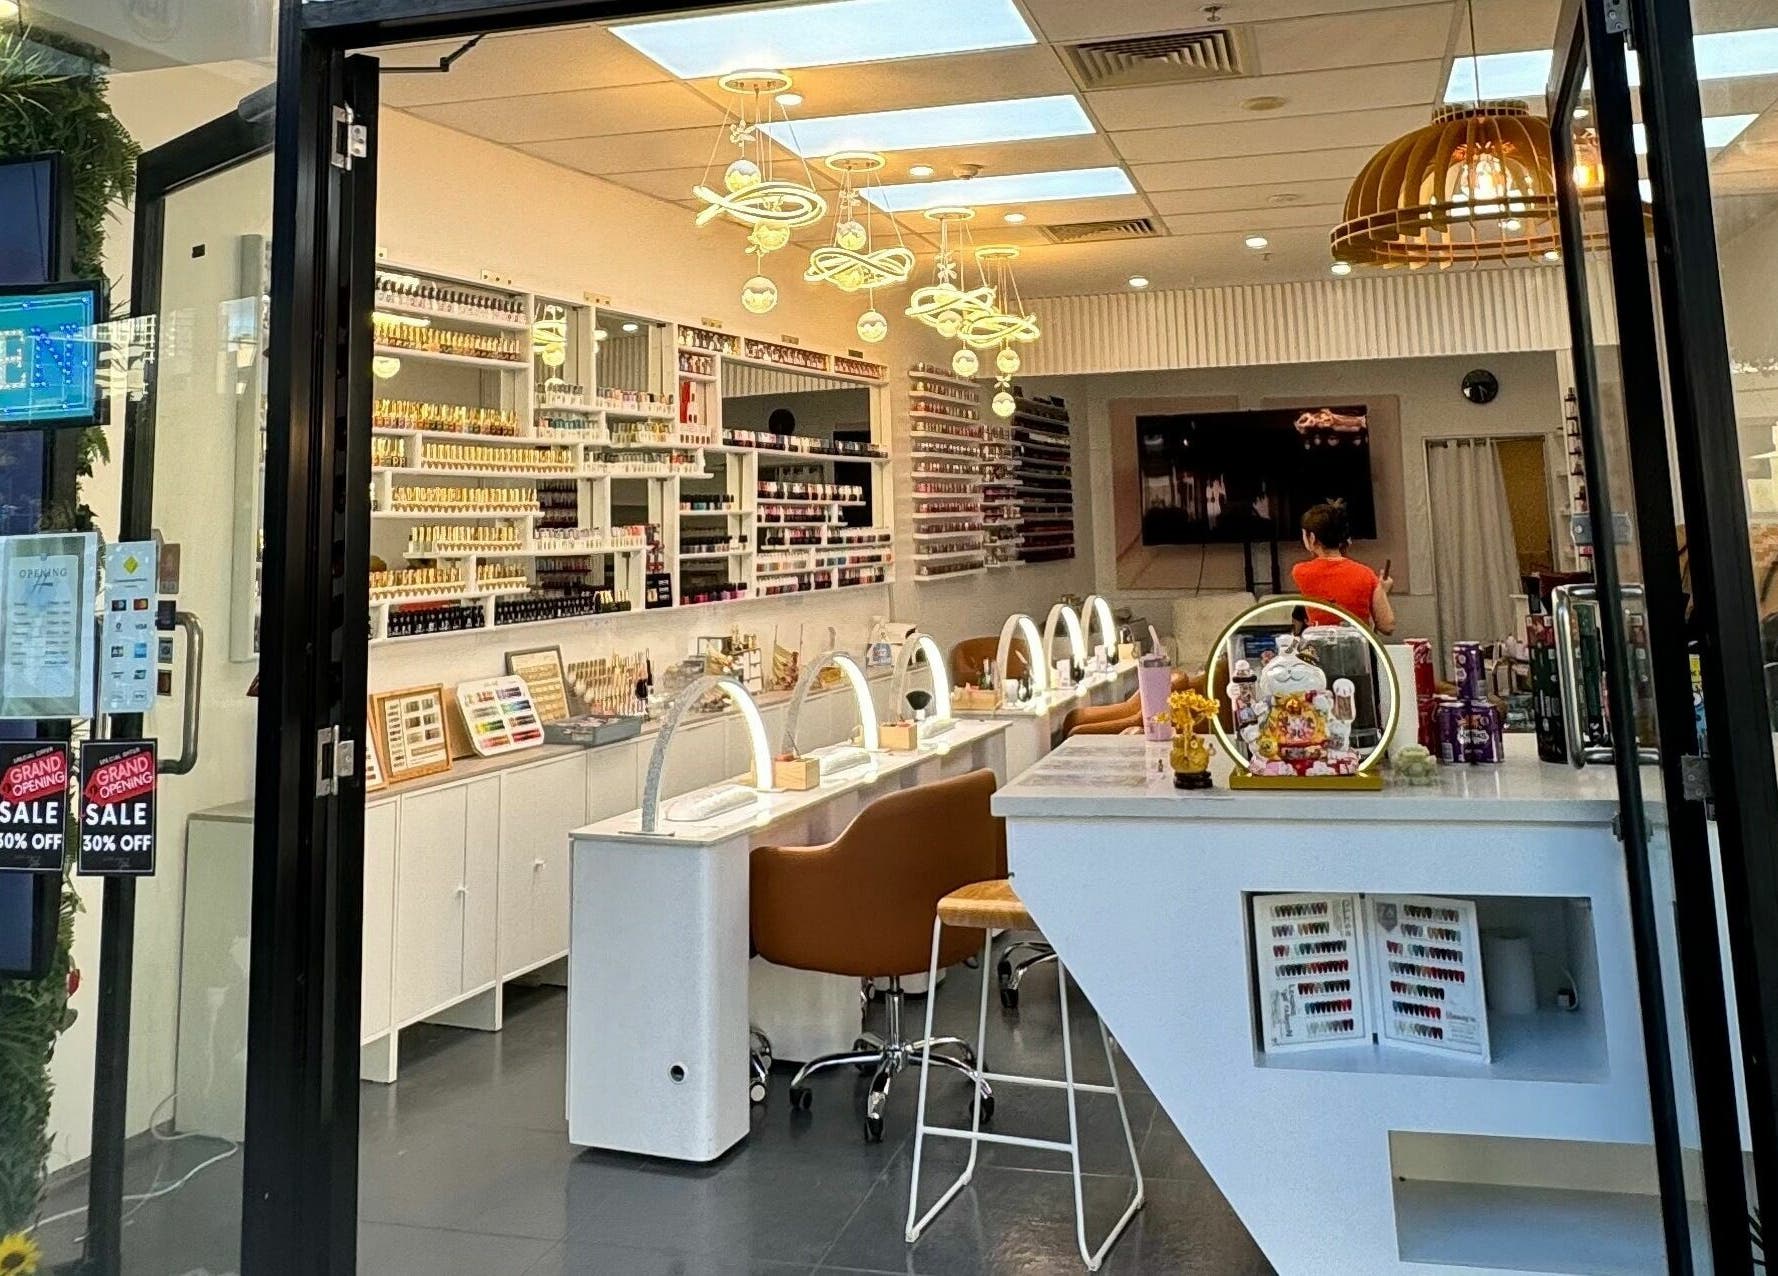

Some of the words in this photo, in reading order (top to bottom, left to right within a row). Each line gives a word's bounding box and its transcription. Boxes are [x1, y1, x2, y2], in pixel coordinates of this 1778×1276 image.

[19, 567, 68, 578] OPENING
[10, 756, 61, 783] GRAND
[96, 756, 149, 786] GRAND
[12, 771, 65, 797] OPENING
[99, 771, 153, 798] OPENING
[0, 801, 59, 824] SALE
[85, 802, 147, 826] SALE
[31, 833, 63, 850] OFF
[82, 834, 116, 852] 30%
[119, 834, 152, 851] OFF
